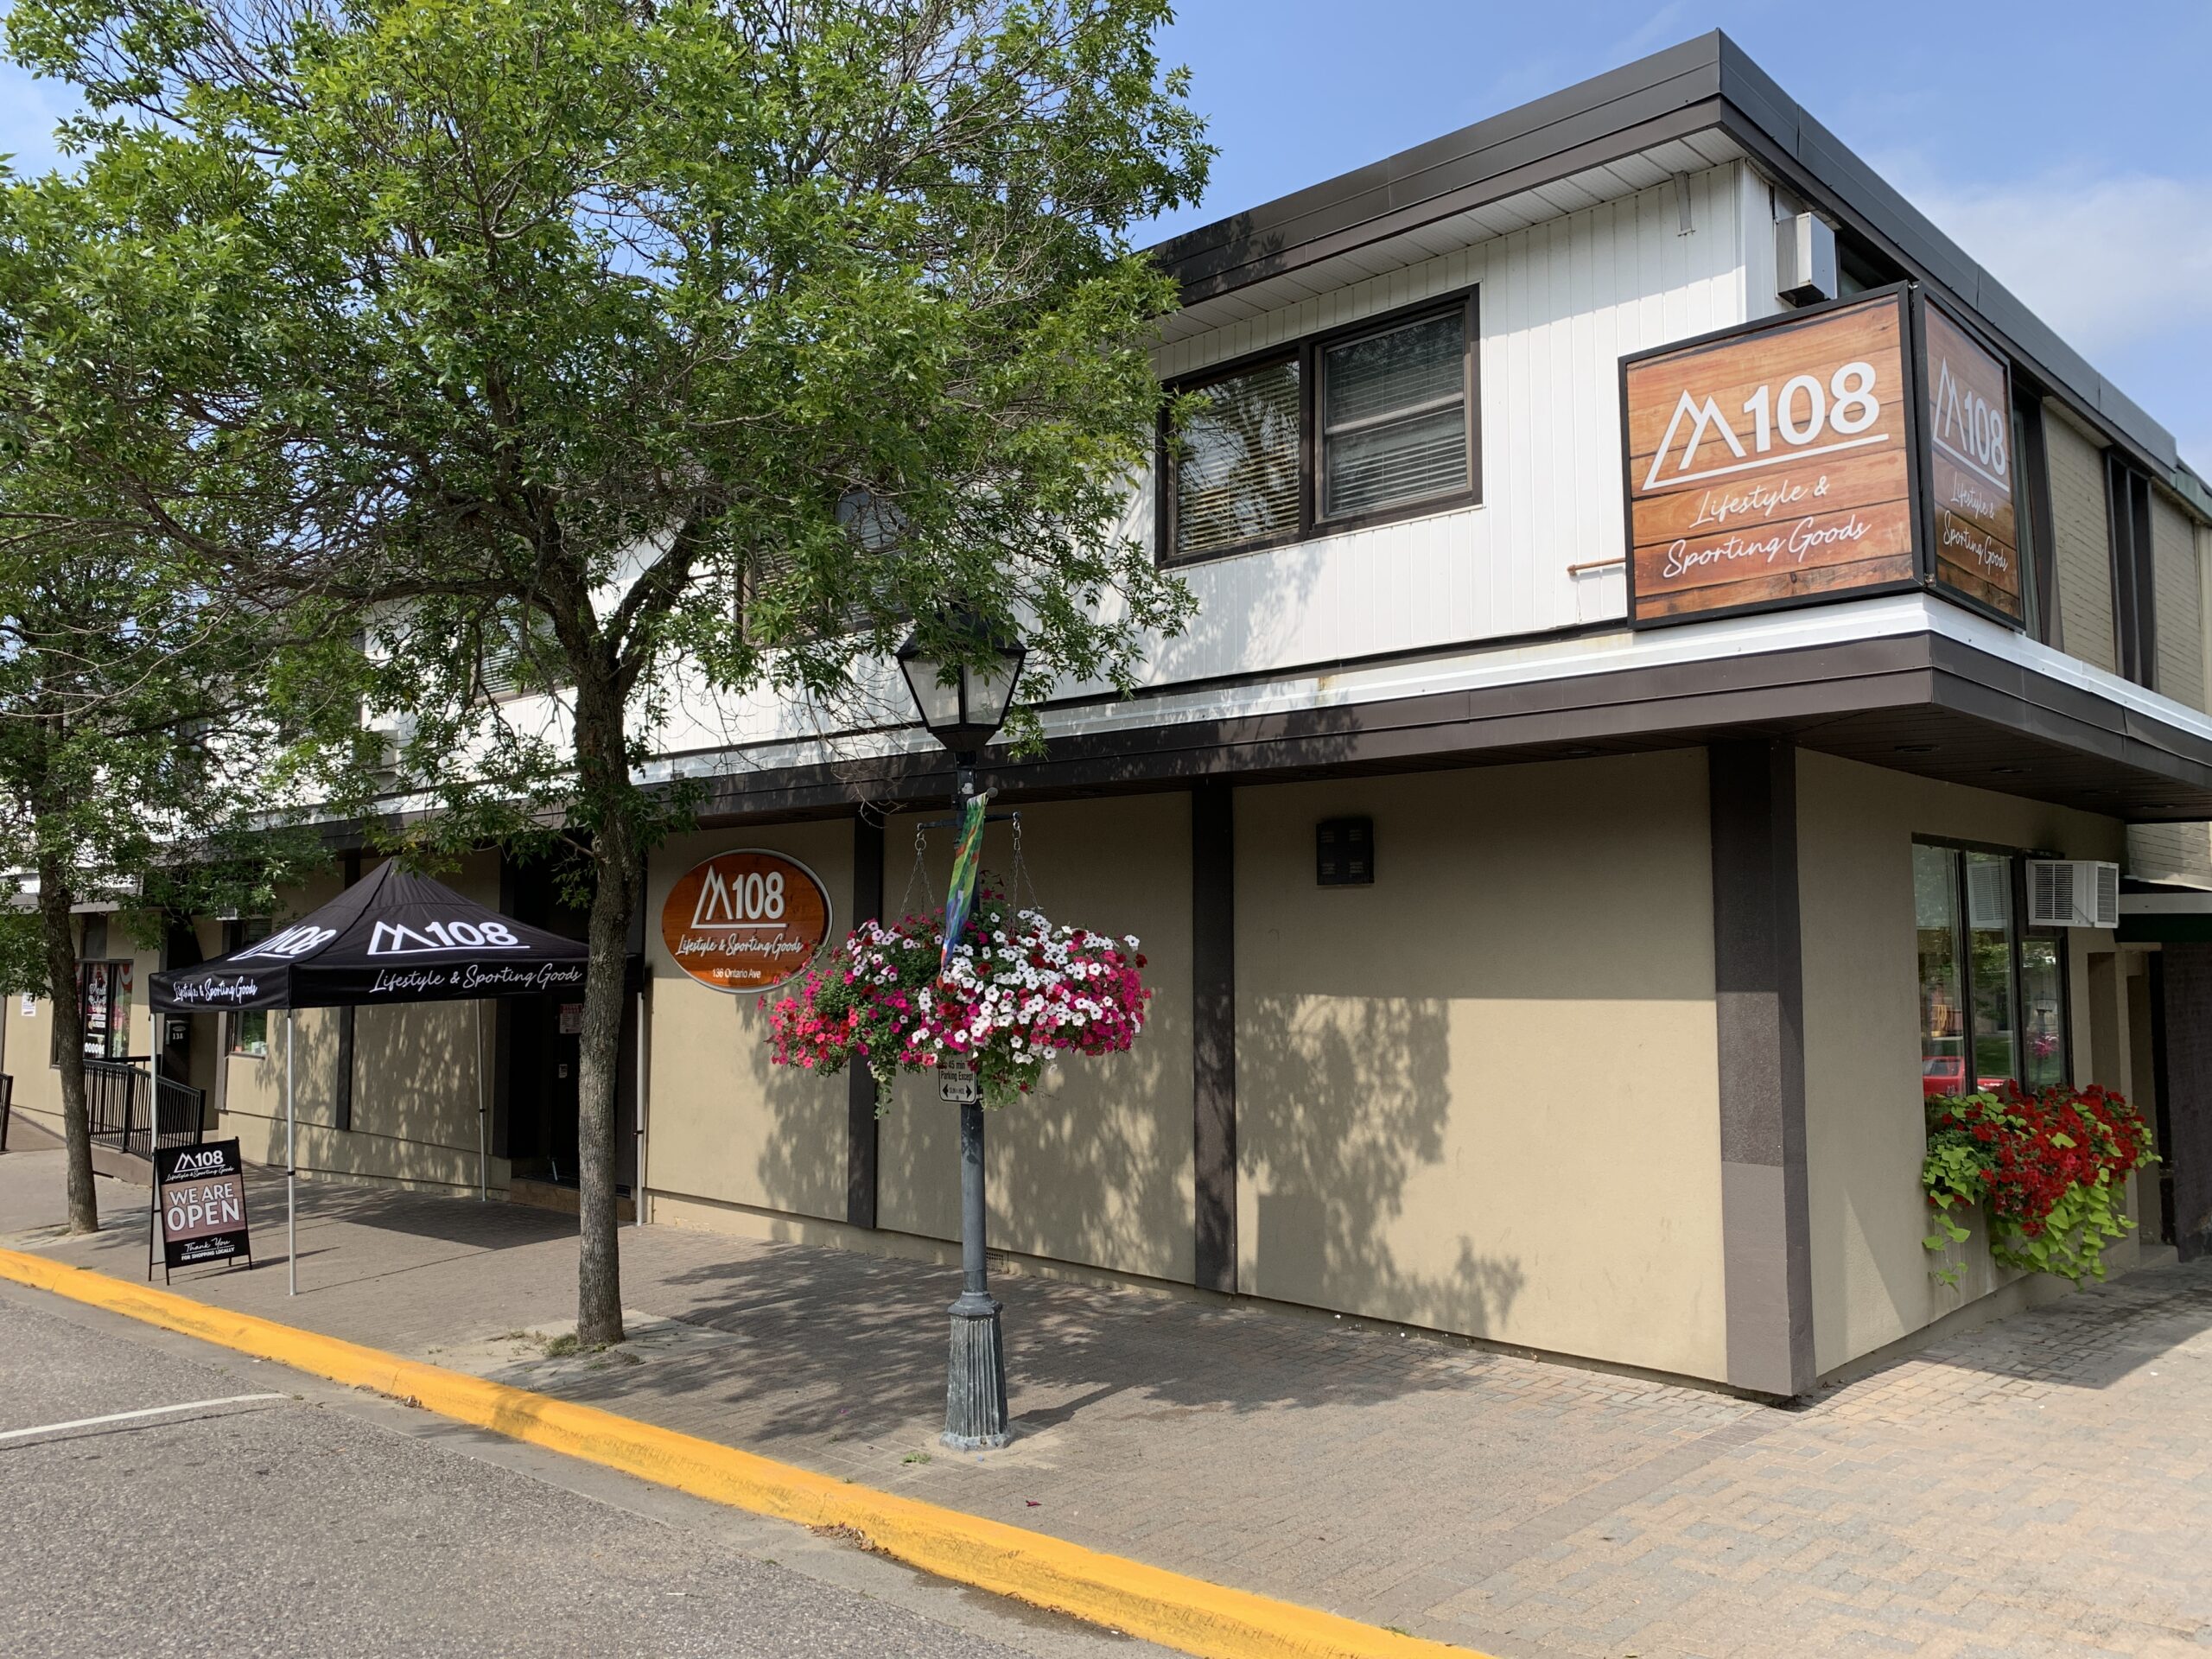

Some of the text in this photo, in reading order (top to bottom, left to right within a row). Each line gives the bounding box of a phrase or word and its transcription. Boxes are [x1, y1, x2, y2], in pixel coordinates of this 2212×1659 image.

[1689, 475, 1830, 529] Lifestyle &
[1950, 471, 1989, 519] Lifestyle
[1662, 514, 1872, 579] Sporting Goods
[1943, 510, 2009, 575] Sporting Goods
[675, 933, 804, 960] Lifestyle & Sporting Goods
[369, 963, 583, 993] Lifestyle & Sporting Goods
[725, 969, 747, 979] Ontario
[748, 969, 761, 979] Ave
[204, 977, 236, 1001] Sporting
[236, 976, 258, 1004] Goods
[940, 1071, 957, 1082] Parking
[193, 1169, 218, 1178] Sporting
[218, 1166, 235, 1175] Goods
[169, 1182, 234, 1206] WE ARE
[167, 1198, 240, 1231] OPEN
[183, 1236, 231, 1253] Thank You
